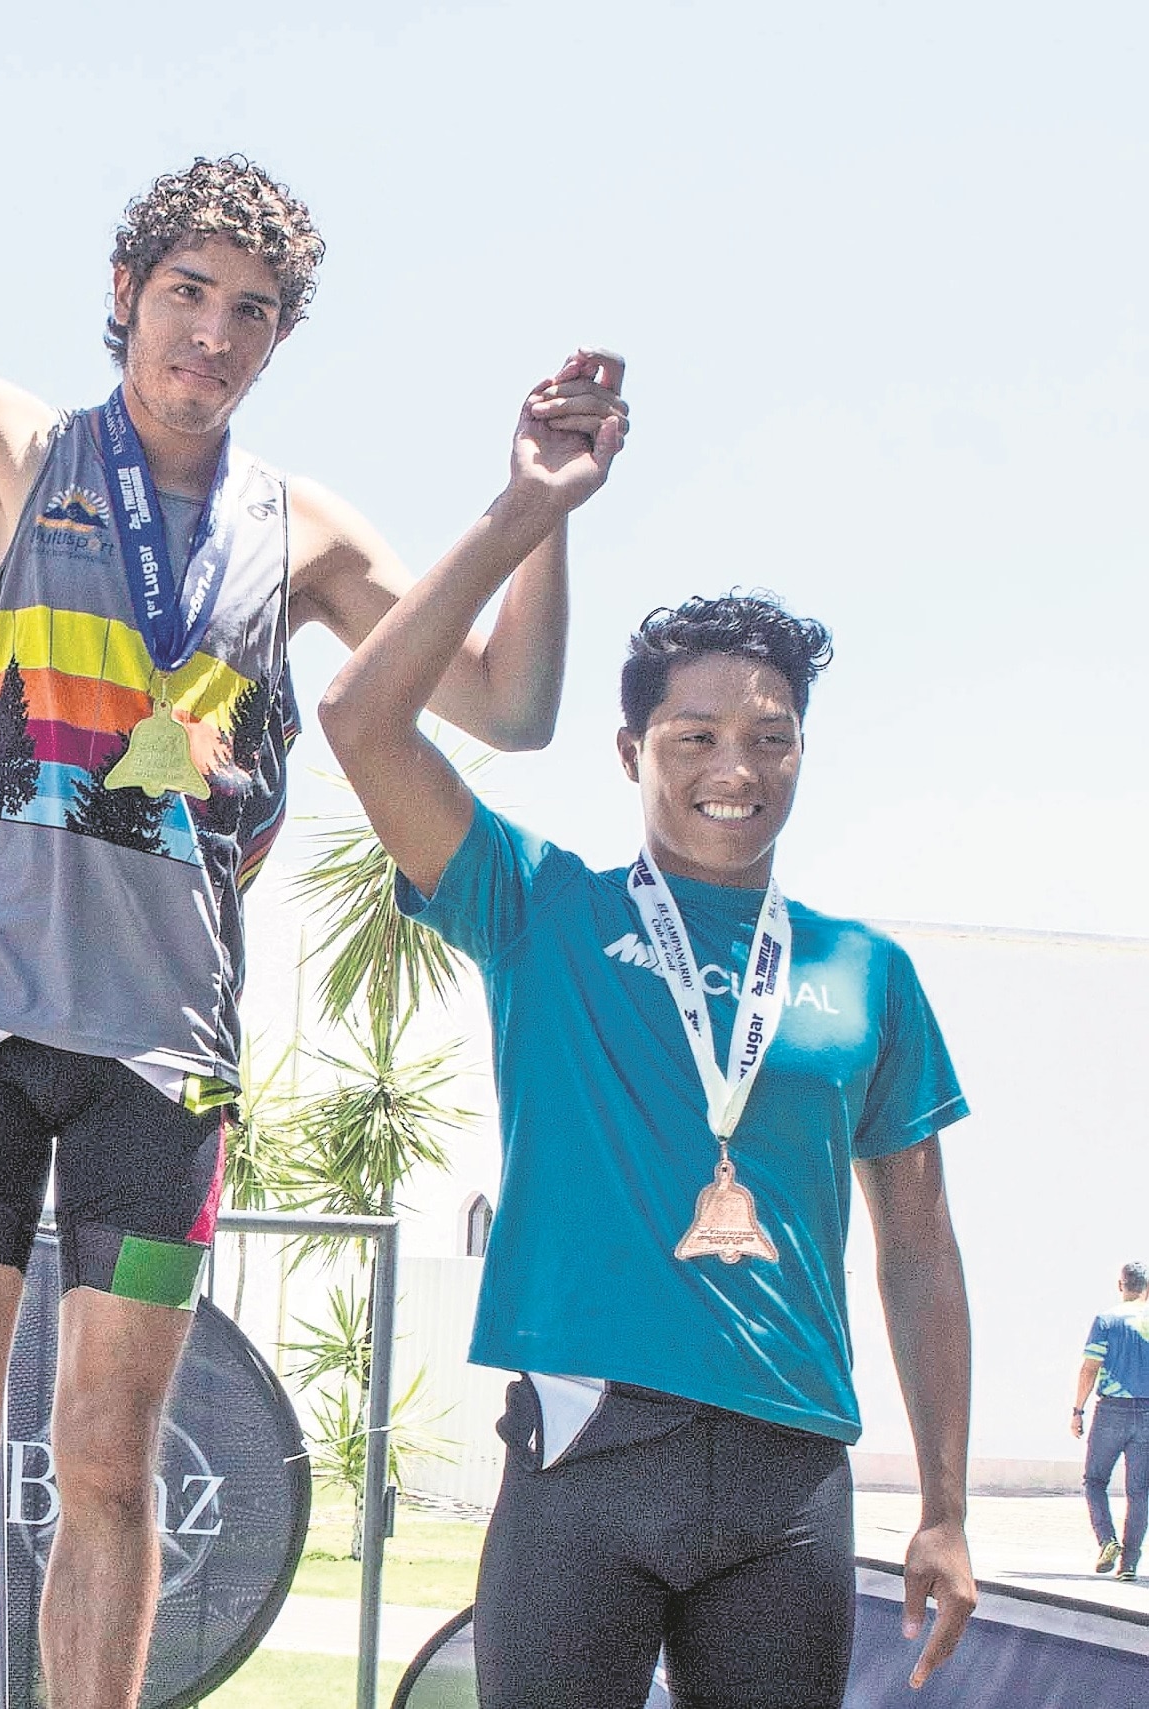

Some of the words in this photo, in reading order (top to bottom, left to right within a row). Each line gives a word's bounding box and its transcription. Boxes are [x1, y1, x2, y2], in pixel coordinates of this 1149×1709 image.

[139, 545, 160, 598] Lugar
[186, 576, 211, 631] Lugar
[657, 902, 669, 917] EL
[651, 918, 663, 938] Club
[659, 939, 668, 951] de
[664, 952, 677, 971] Golf
[744, 1013, 765, 1066] Lugar
